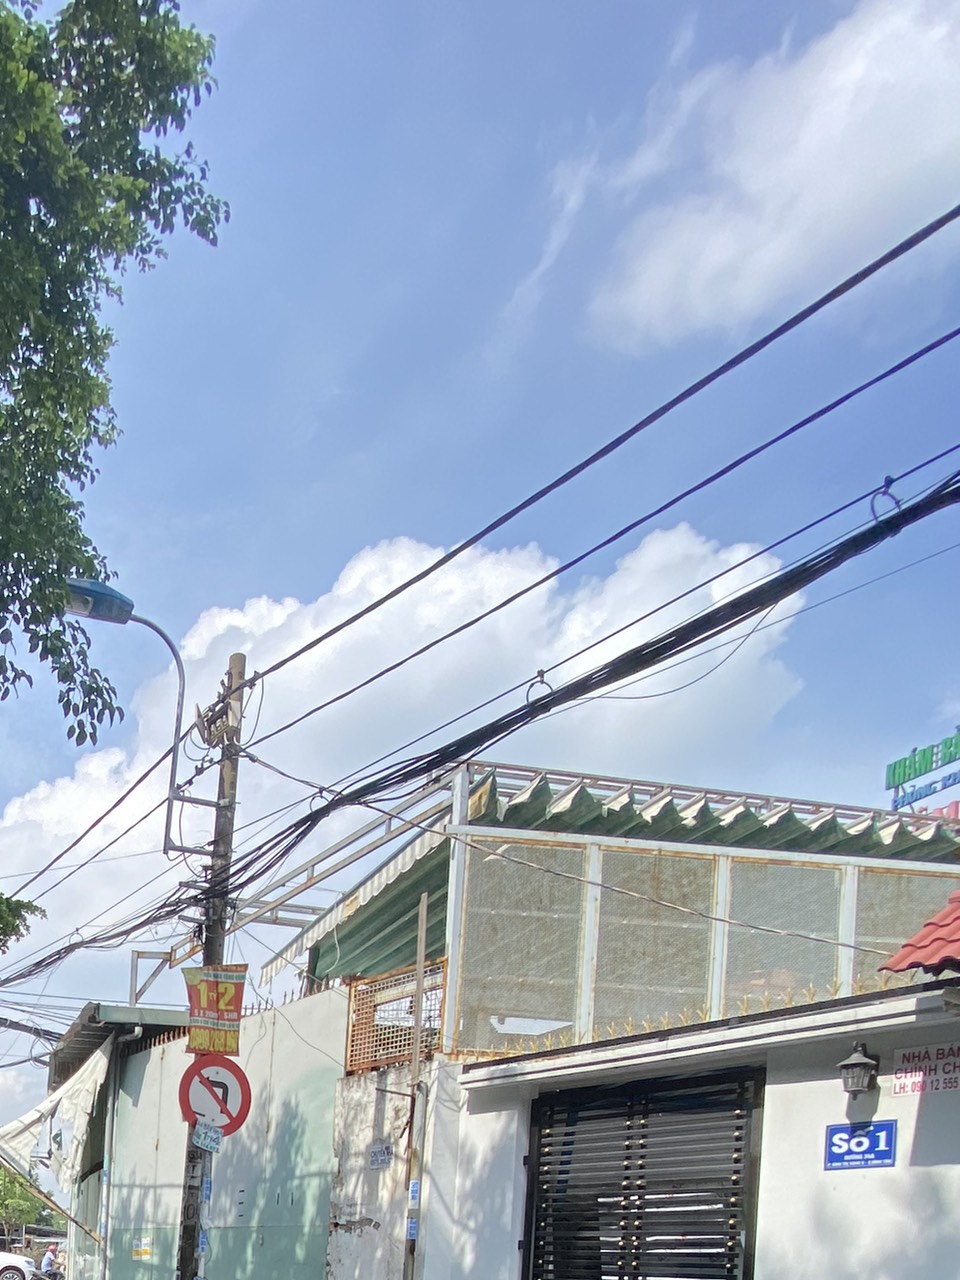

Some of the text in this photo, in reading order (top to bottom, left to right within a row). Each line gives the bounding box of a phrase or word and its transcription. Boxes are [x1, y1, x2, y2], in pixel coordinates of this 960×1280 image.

[886, 746, 934, 790] KHÁM
[218, 982, 236, 1010] 2
[902, 1047, 931, 1065] NHÀ
[895, 1063, 937, 1080] CHÍNH
[893, 1077, 959, 1095] LH: 090 12 555
[831, 1126, 889, 1154] Số 1
